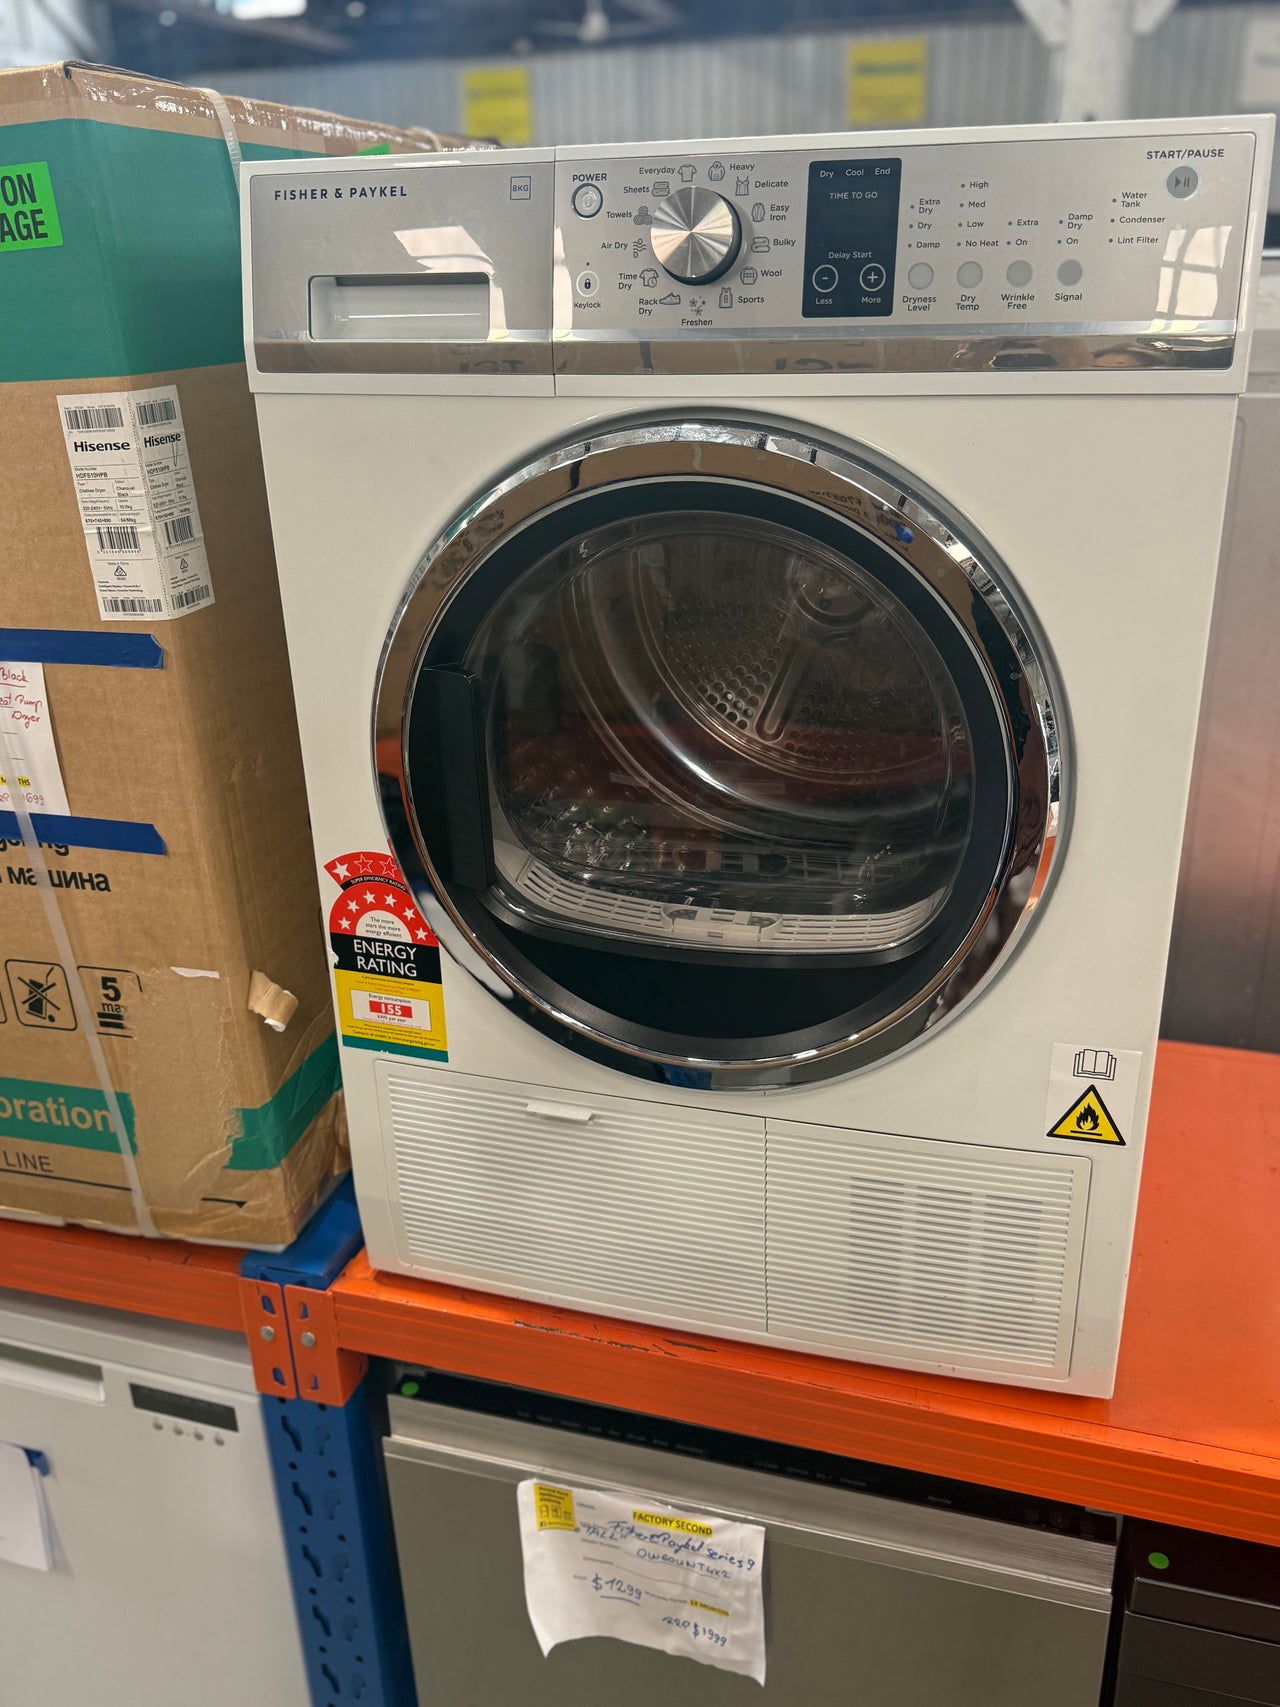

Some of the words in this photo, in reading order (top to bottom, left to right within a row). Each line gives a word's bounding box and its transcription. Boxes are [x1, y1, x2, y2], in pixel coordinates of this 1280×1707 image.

[1146, 148, 1225, 160] START/PAUSE
[639, 165, 676, 176] Everyday
[729, 162, 755, 173] Heavy
[819, 169, 834, 179] Dry
[845, 167, 864, 177] Cool
[874, 166, 890, 176] End
[572, 172, 607, 183] POWER
[512, 184, 529, 193] 8KG
[754, 179, 789, 189] Delicate
[969, 180, 989, 190] High
[1, 173, 37, 206] ON
[274, 188, 328, 201] FISHER
[334, 187, 343, 199] &
[350, 185, 408, 198] PAYKEL
[623, 185, 650, 195] Sheets
[829, 191, 848, 200] TIME
[849, 191, 861, 200] TO
[864, 190, 879, 199] GO
[1121, 190, 1148, 200] Water
[918, 198, 941, 207] Extra
[968, 200, 986, 209] Med
[1120, 199, 1141, 208] Tank
[770, 203, 790, 214] Easy
[918, 206, 933, 216] Dry
[606, 210, 633, 220] Towels
[770, 213, 786, 221] Iron
[1067, 212, 1093, 222] Damp
[1119, 215, 1166, 225] Condenser
[0, 208, 48, 243] AGE
[917, 221, 932, 231] Dry
[966, 220, 984, 229] Low
[1016, 218, 1039, 227] Extra
[1067, 221, 1083, 231] Dry
[773, 237, 796, 248] Bulky
[916, 240, 941, 250] Damp
[965, 239, 975, 248] No
[977, 239, 999, 248] Heat
[1015, 238, 1028, 247] On
[1066, 237, 1079, 246] On
[1117, 236, 1133, 245] Lint
[1135, 235, 1159, 245] Filter
[601, 241, 613, 250] Air
[613, 241, 628, 251] Dry
[828, 251, 850, 261] Delay
[851, 250, 872, 260] Start
[618, 272, 638, 281] Time
[760, 268, 782, 278] Wool
[618, 281, 633, 291] Dry
[638, 297, 658, 306] Rack
[737, 295, 765, 305] Sports
[815, 297, 833, 305] Less
[861, 296, 881, 305] More
[902, 294, 936, 305] Dryness
[960, 294, 976, 304] Dry
[1001, 292, 1035, 302] Wrinkle
[1054, 292, 1083, 303] Signal
[573, 300, 602, 310] Keylock
[907, 303, 930, 312] Level
[956, 302, 980, 312] Temp
[1007, 301, 1027, 310] Free
[638, 306, 653, 316] Dry
[681, 317, 713, 327] Freshen
[144, 432, 181, 448] Hisense
[73, 441, 131, 453] Hisense
[353, 939, 417, 960] ENERGY
[356, 956, 417, 977] RATING
[101, 976, 121, 1001] 5
[380, 1003, 402, 1015] 155
[4, 1152, 53, 1173] LINE
[633, 1511, 674, 1527] FACTORY
[675, 1520, 713, 1536] SECOND
